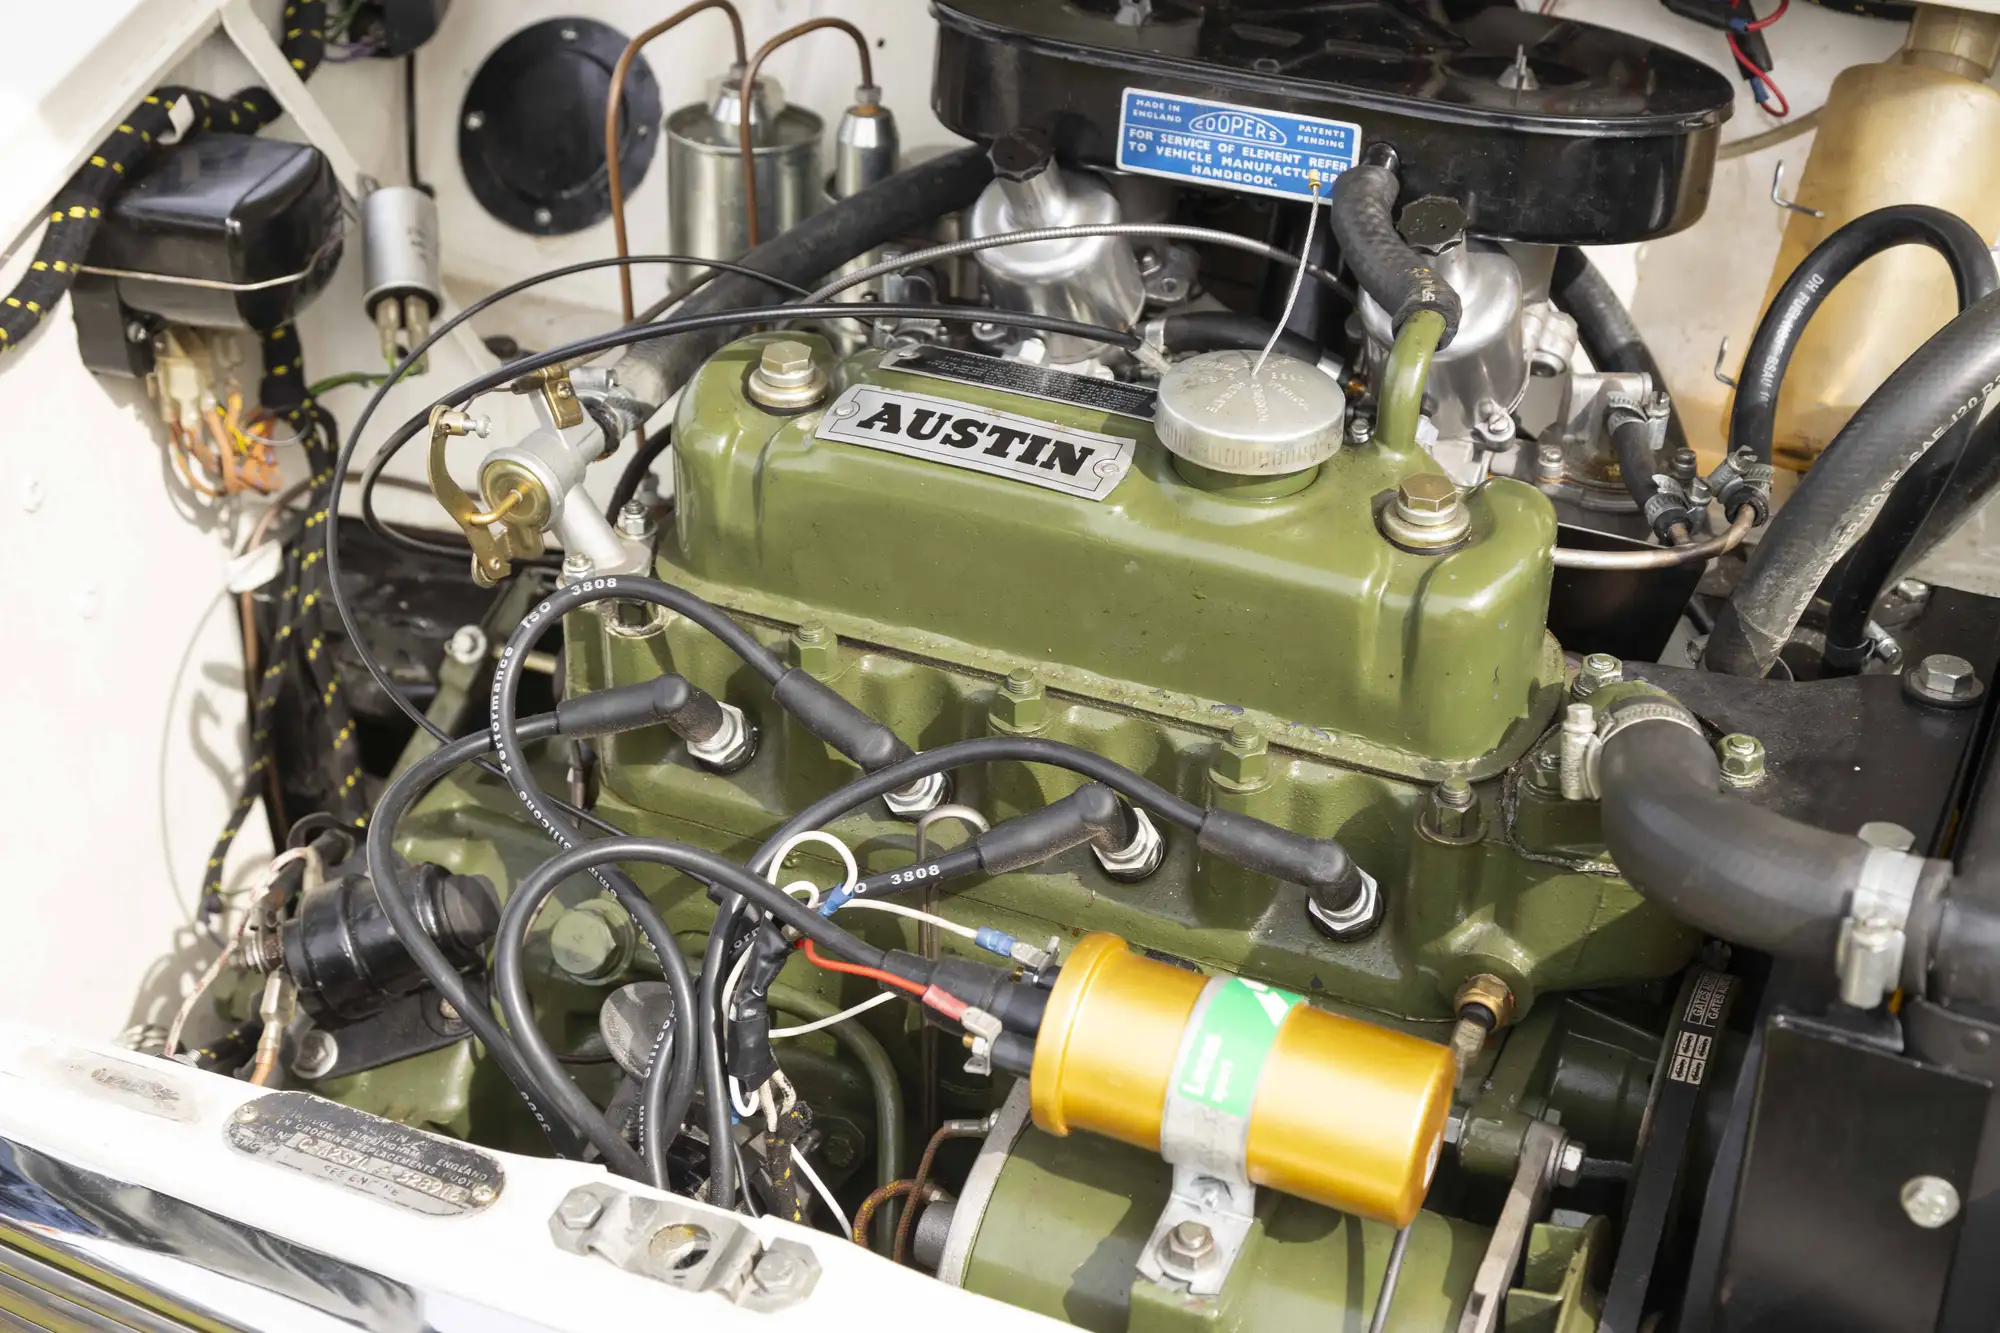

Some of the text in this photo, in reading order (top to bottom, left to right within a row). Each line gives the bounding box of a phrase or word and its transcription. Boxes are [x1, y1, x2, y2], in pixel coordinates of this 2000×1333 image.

[1132, 109, 1182, 123] ENGLAND
[1135, 98, 1181, 112] MADE IN
[1297, 135, 1345, 149] PENDING
[1298, 124, 1346, 138] PATENTS
[1128, 140, 1147, 153] TO
[1155, 145, 1212, 164] VEHICLE
[1129, 128, 1348, 172] FOR SERVICE OF ELEMENT REFER
[1191, 164, 1278, 187] HANDBOOK.
[856, 401, 1096, 476] AUSTIN
[492, 646, 513, 776] Performance
[521, 601, 551, 629] ISO
[570, 577, 617, 596] 3808
[890, 864, 940, 885] 3808
[1692, 989, 1709, 1017] GATES
[1707, 994, 1726, 1019] GATES
[294, 1122, 350, 1145] ORDERING
[352, 1142, 437, 1174] REPLACEMENTS
[435, 1157, 488, 1181] ENGLAND
